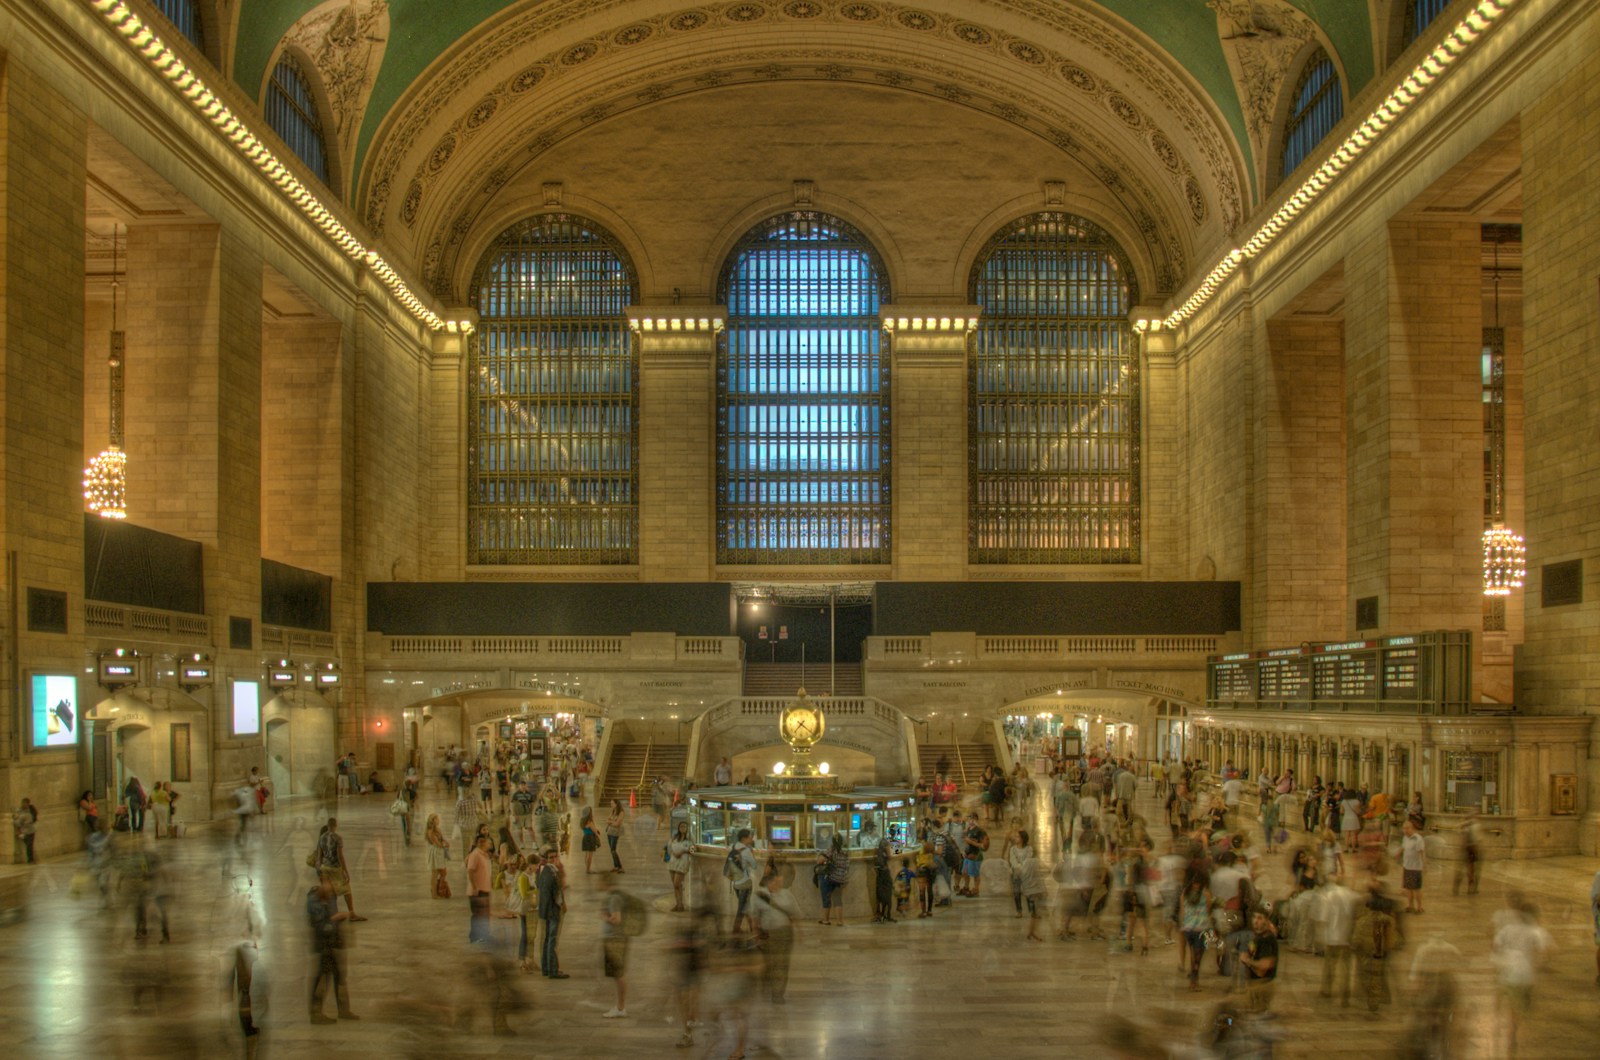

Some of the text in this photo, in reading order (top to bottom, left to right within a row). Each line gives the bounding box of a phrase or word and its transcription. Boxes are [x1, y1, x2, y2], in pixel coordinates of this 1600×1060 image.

[519, 680, 566, 694] LEXINGTON
[1025, 680, 1089, 697] LEXINGTON AVE
[1115, 680, 1185, 697] TICKET MACHINES
[1063, 704, 1091, 712] SUBWAY
